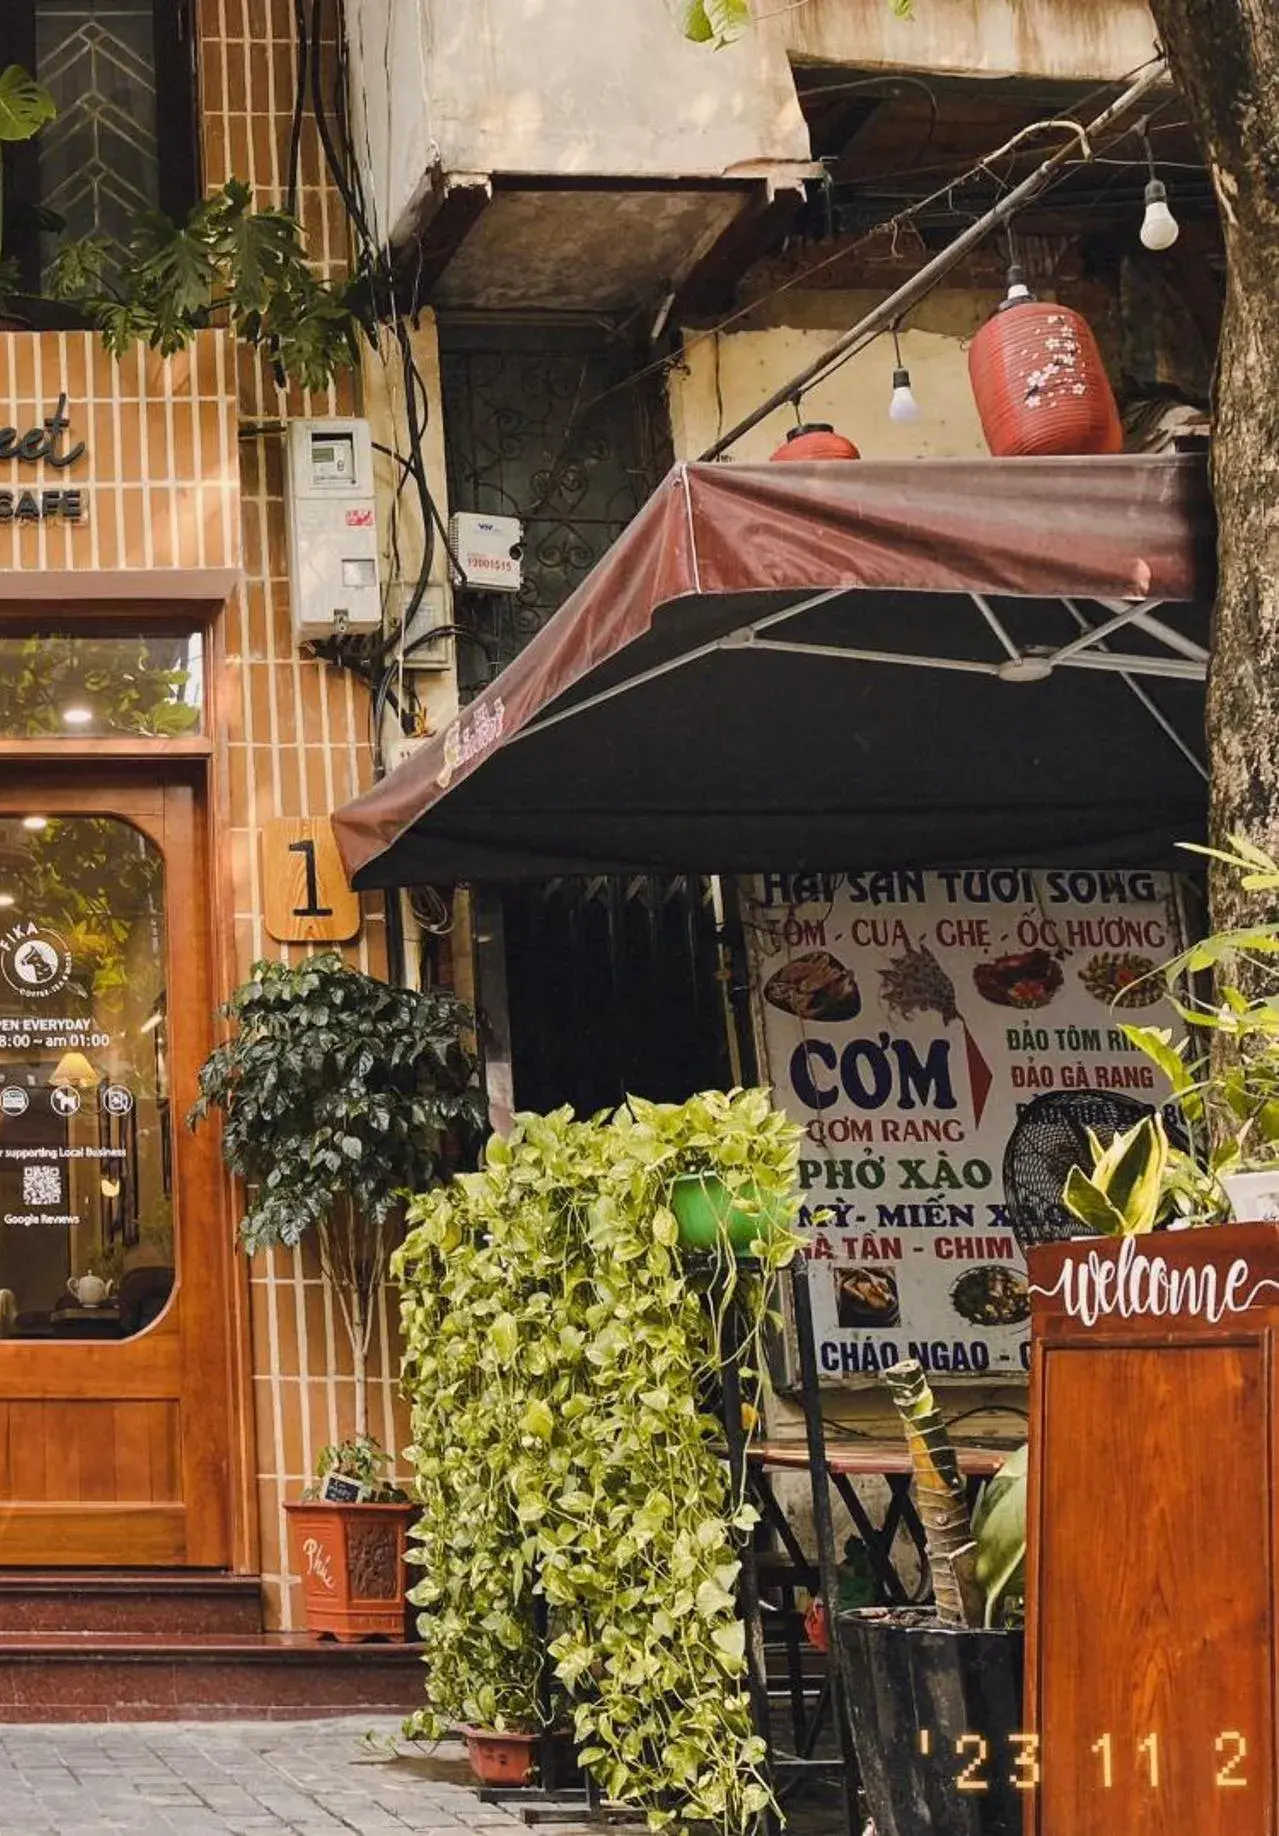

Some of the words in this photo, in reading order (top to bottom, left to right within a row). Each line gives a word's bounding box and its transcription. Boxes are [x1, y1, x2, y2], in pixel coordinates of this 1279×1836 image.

[289, 840, 333, 916] 1
[0, 921, 39, 951] FIKA
[851, 918, 911, 948] CUA
[1066, 916, 1165, 948] HƯƠNG
[23, 1018, 91, 1031] EVERYDAY
[1054, 1025, 1101, 1051] TÔM
[45, 1036, 67, 1047] am
[70, 1034, 110, 1047] 01:00
[790, 1031, 958, 1110] CƠM
[1095, 1066, 1154, 1088] RANG
[881, 1118, 965, 1142] RANG
[5, 1148, 58, 1160] supporting
[59, 1147, 84, 1158] Local
[86, 1147, 127, 1158] Business
[798, 1147, 886, 1190] PHỞ
[898, 1150, 993, 1190] XÀO
[4, 1214, 39, 1227] Google
[40, 1213, 80, 1225] Reviews
[876, 1194, 975, 1228] MIẾN
[842, 1229, 903, 1259] TẦN
[934, 1236, 1015, 1260] CHIM
[1032, 1236, 1279, 1328] welcome
[821, 1336, 899, 1371] CHÁO
[908, 1341, 989, 1371] NGAO
